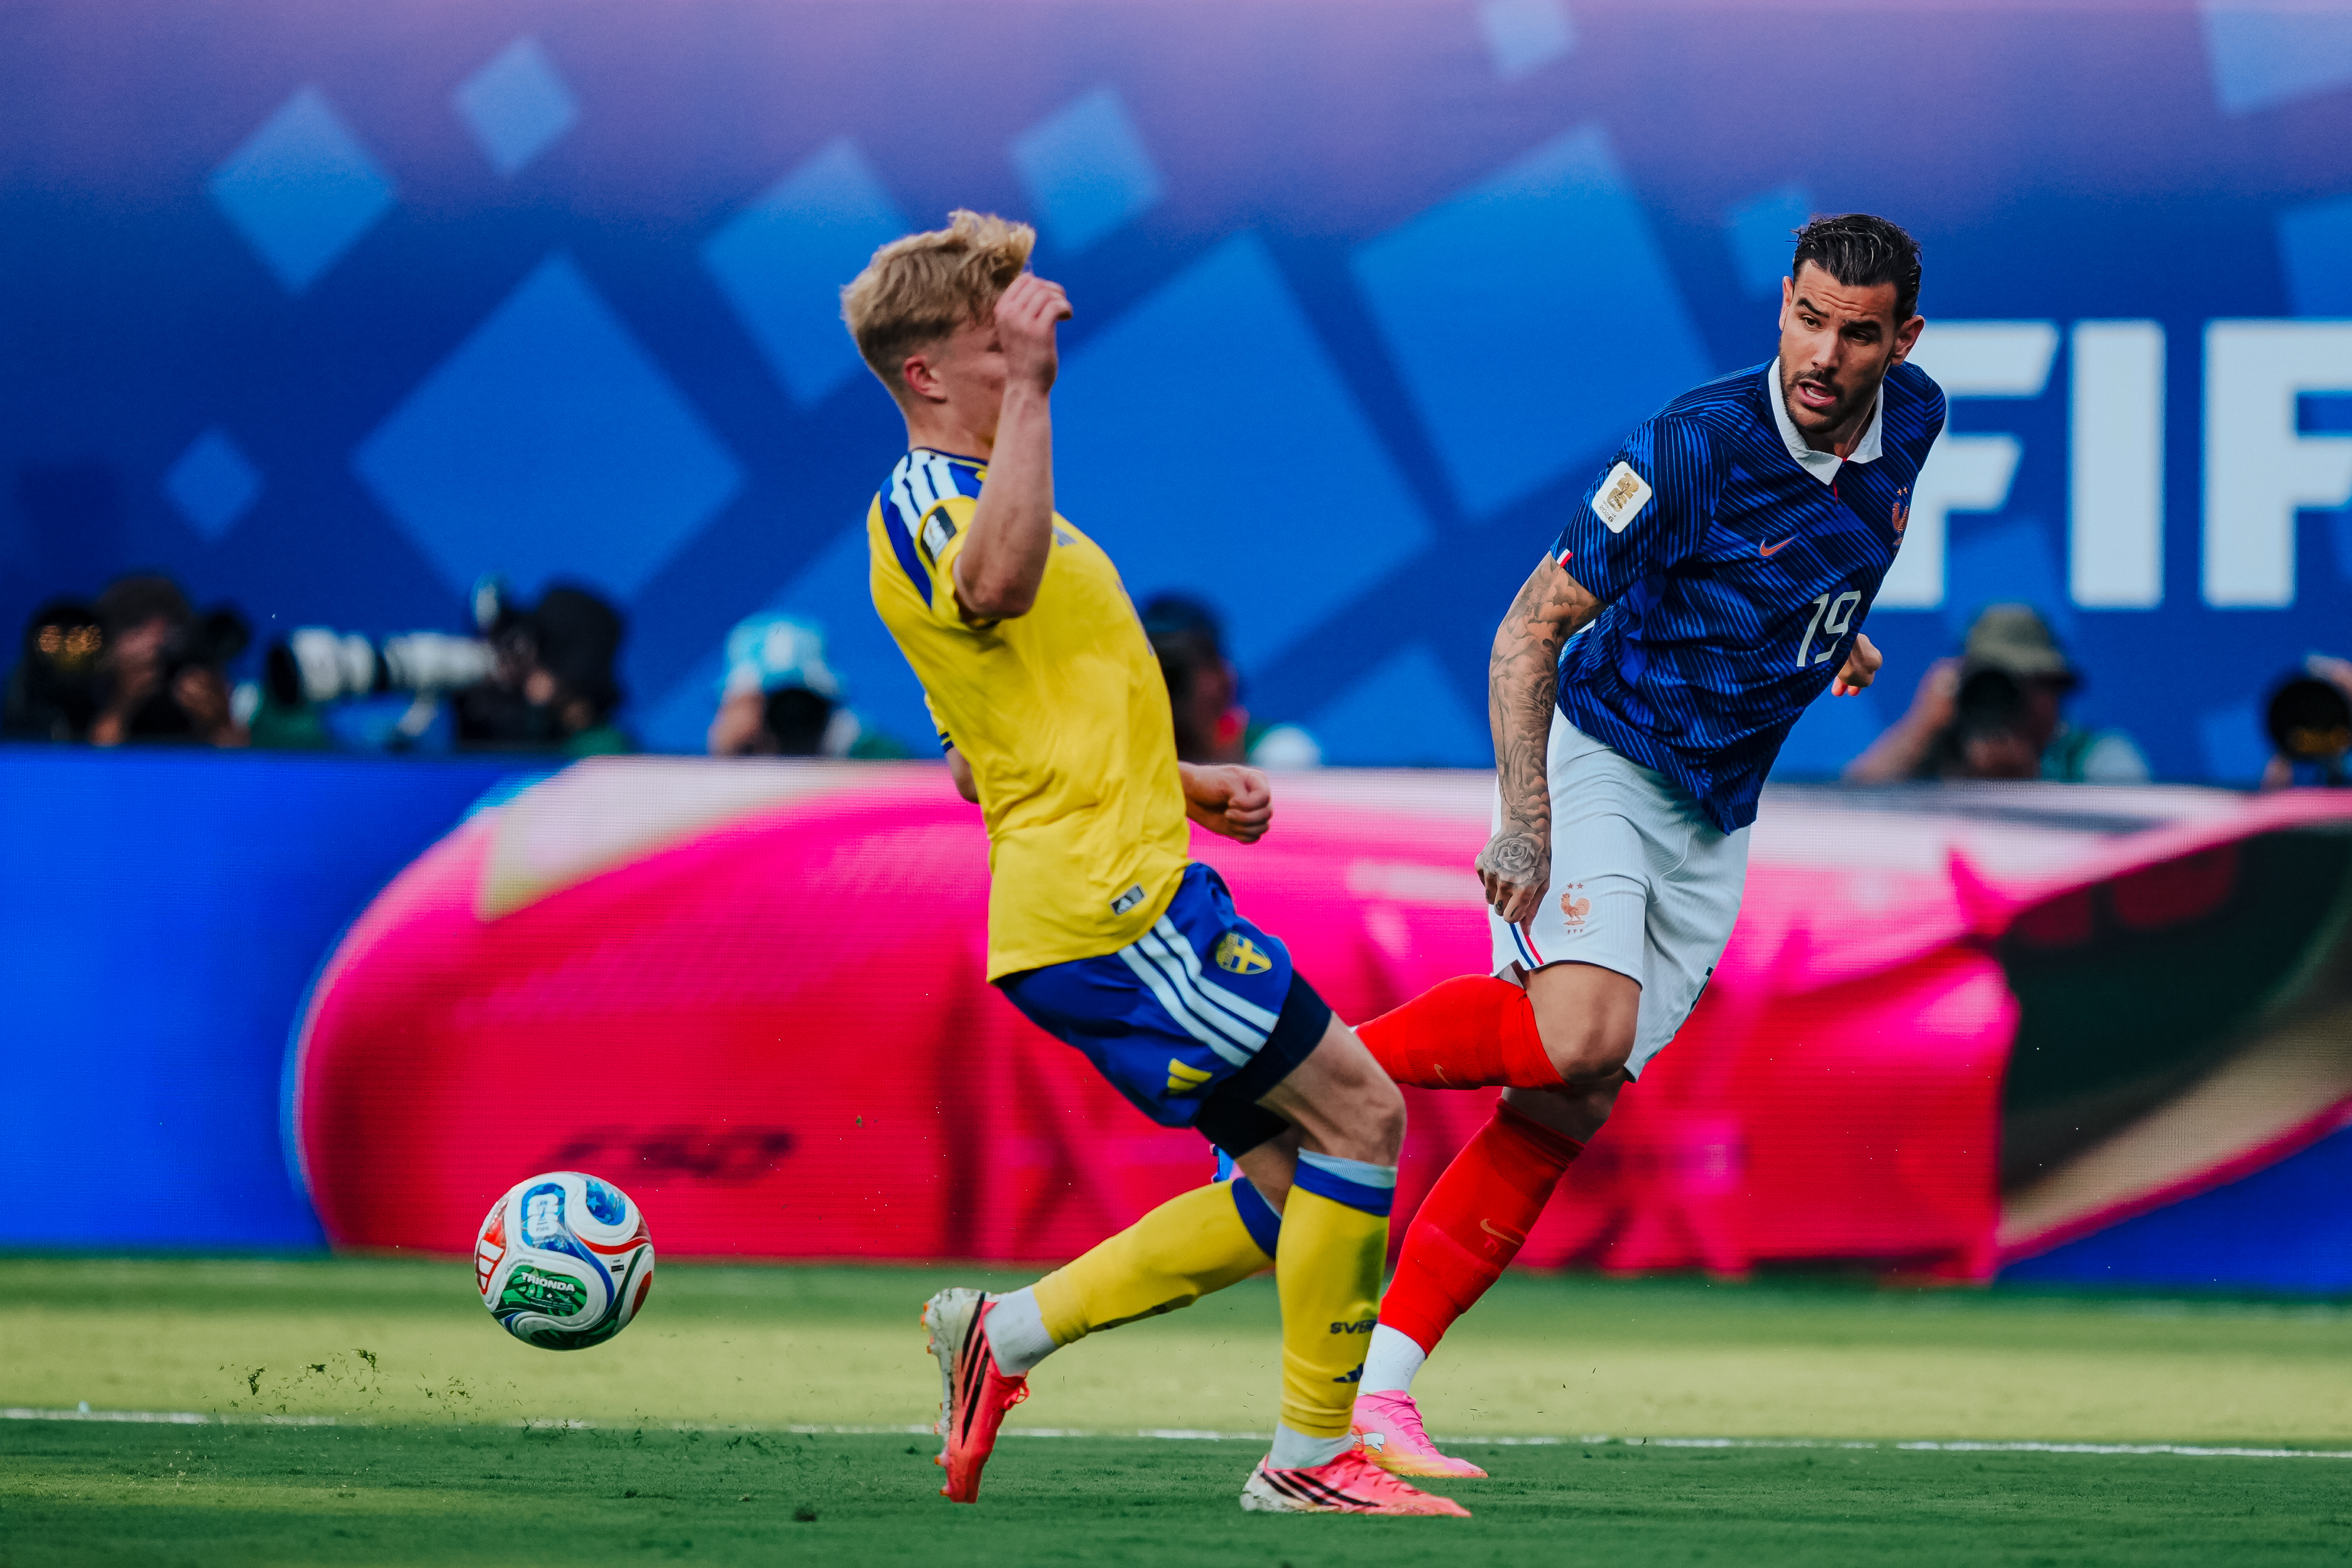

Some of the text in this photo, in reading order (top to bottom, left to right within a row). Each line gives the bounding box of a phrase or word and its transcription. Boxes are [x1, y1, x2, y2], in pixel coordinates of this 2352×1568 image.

[1599, 504, 1614, 522] 2026
[1797, 591, 1861, 667] 19
[521, 1271, 575, 1292] TRIONDA
